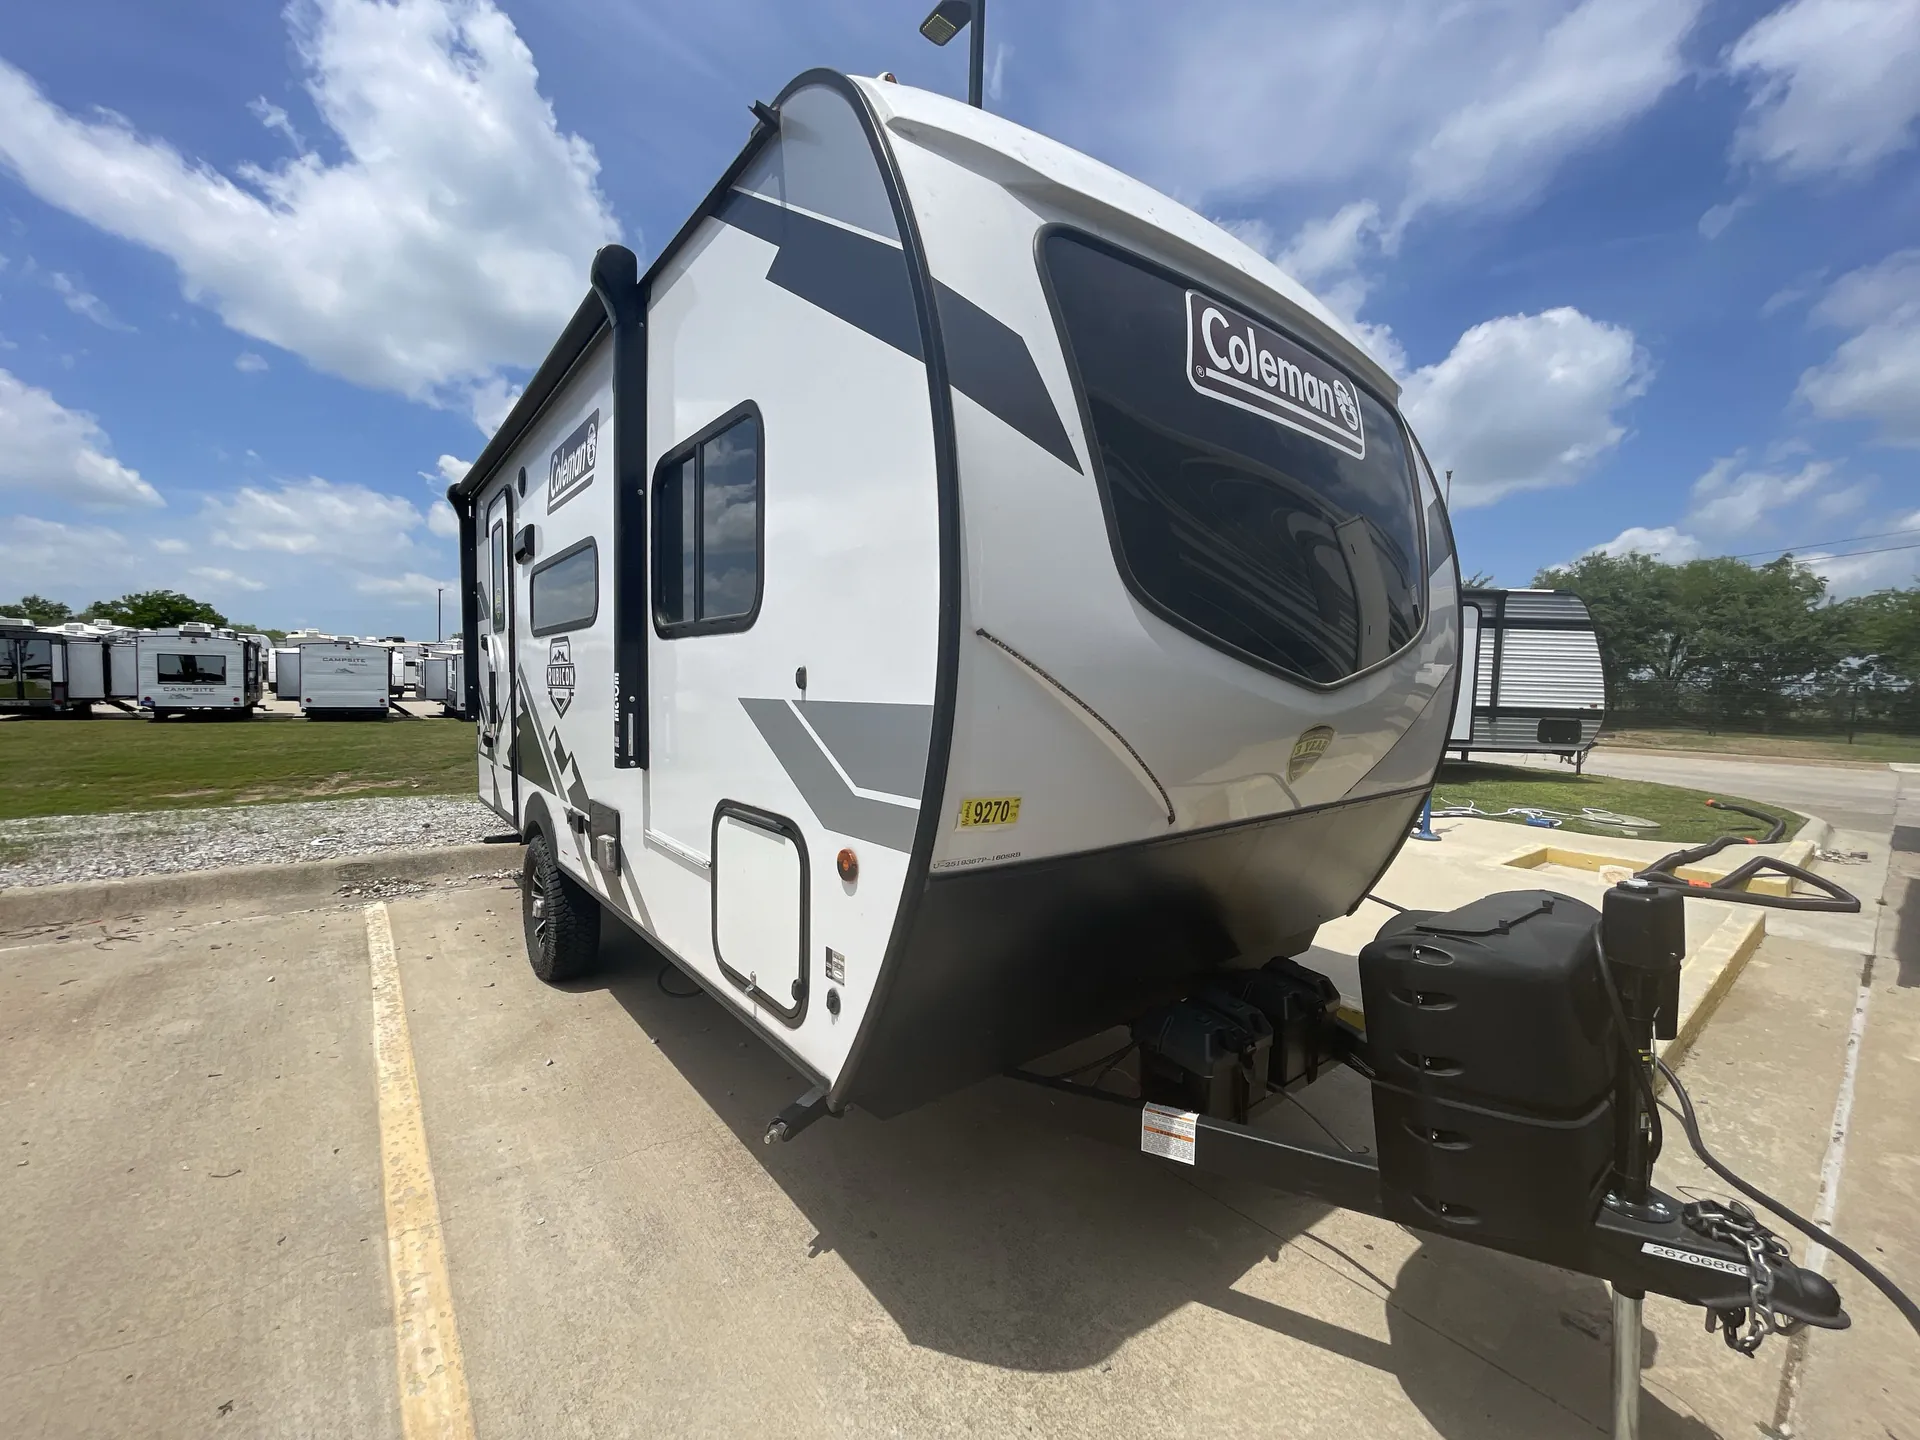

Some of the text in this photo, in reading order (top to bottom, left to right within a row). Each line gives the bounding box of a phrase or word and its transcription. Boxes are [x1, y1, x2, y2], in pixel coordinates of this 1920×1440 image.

[1201, 307, 1336, 418] Coleman
[550, 441, 587, 498] Coleman
[548, 667, 573, 685] RUBICON
[1305, 740, 1329, 752] YEAR
[974, 800, 1010, 824] 9270
